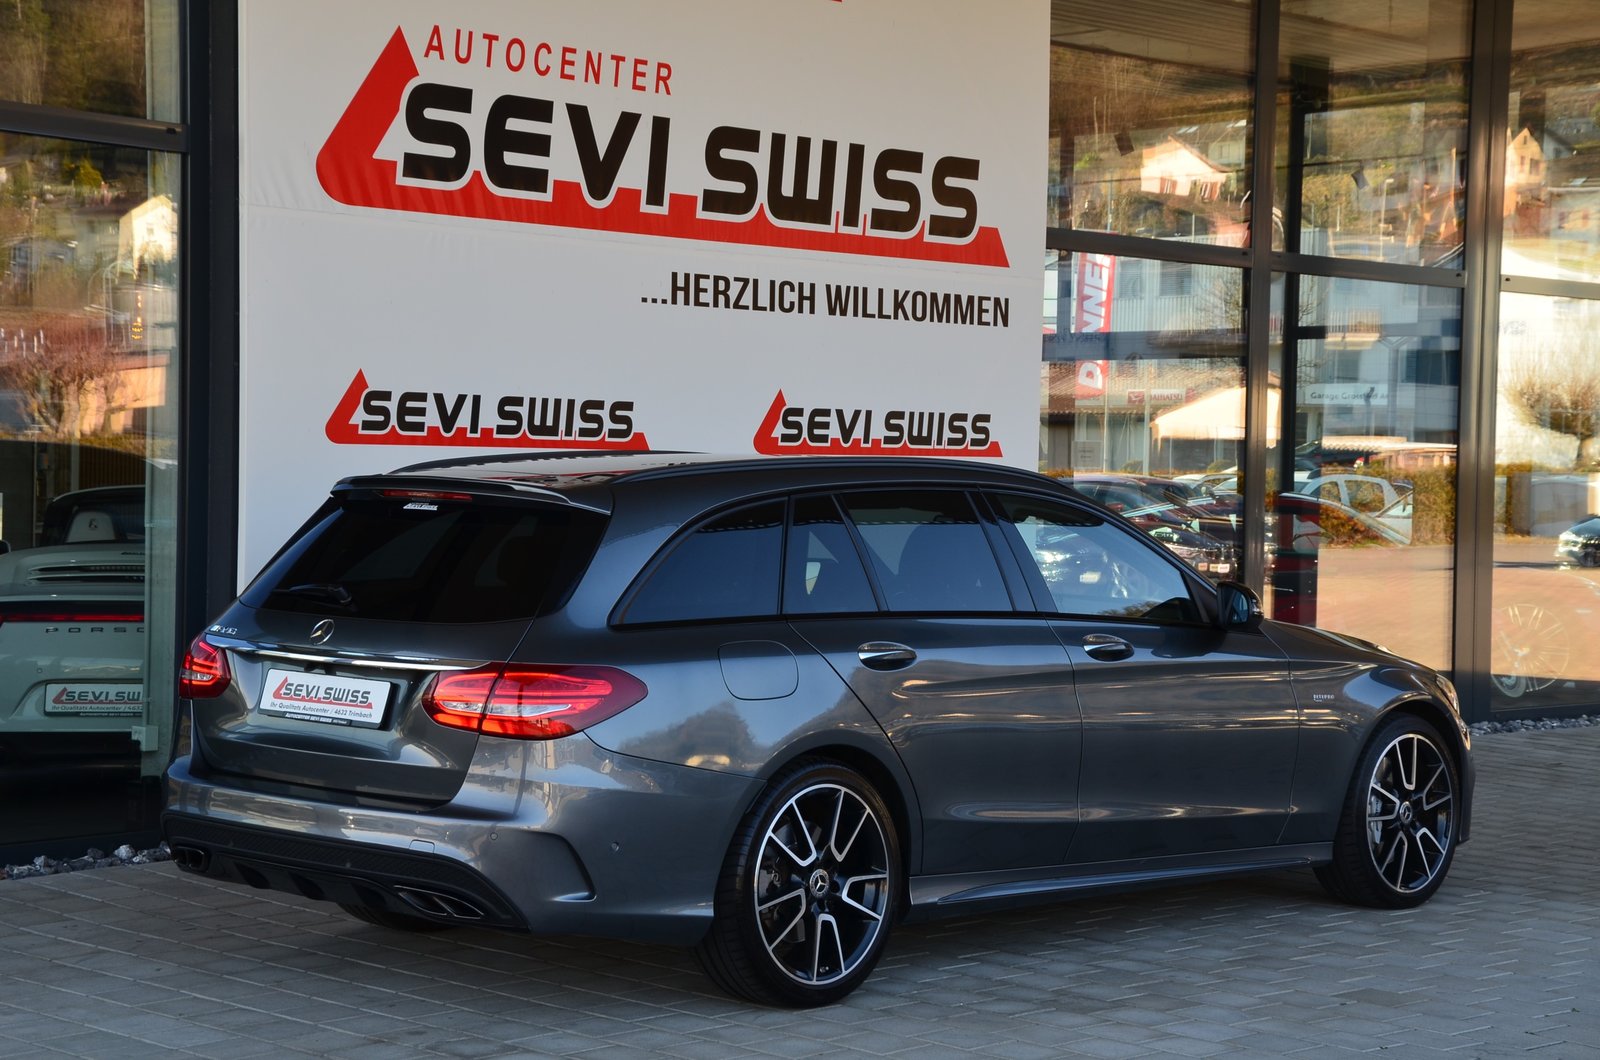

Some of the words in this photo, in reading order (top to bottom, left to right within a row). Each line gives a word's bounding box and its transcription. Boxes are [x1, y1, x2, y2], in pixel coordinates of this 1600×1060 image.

[424, 25, 673, 95] AUTOCENTER
[403, 83, 671, 207] SEVI
[701, 126, 980, 239] SWISS
[826, 284, 1010, 328] WILLKOMMEN
[361, 390, 482, 435] SEVI
[495, 396, 634, 439] SWISS
[1310, 392, 1338, 400] Garage
[780, 407, 873, 445] SEVI
[883, 411, 991, 447] SWISS
[65, 691, 110, 701] SEVI
[283, 683, 320, 699] SEVI
[323, 687, 371, 704] SWISS
[302, 705, 330, 714] Autocenter
[334, 708, 348, 716] 4632
[348, 710, 373, 719] Trimbach
